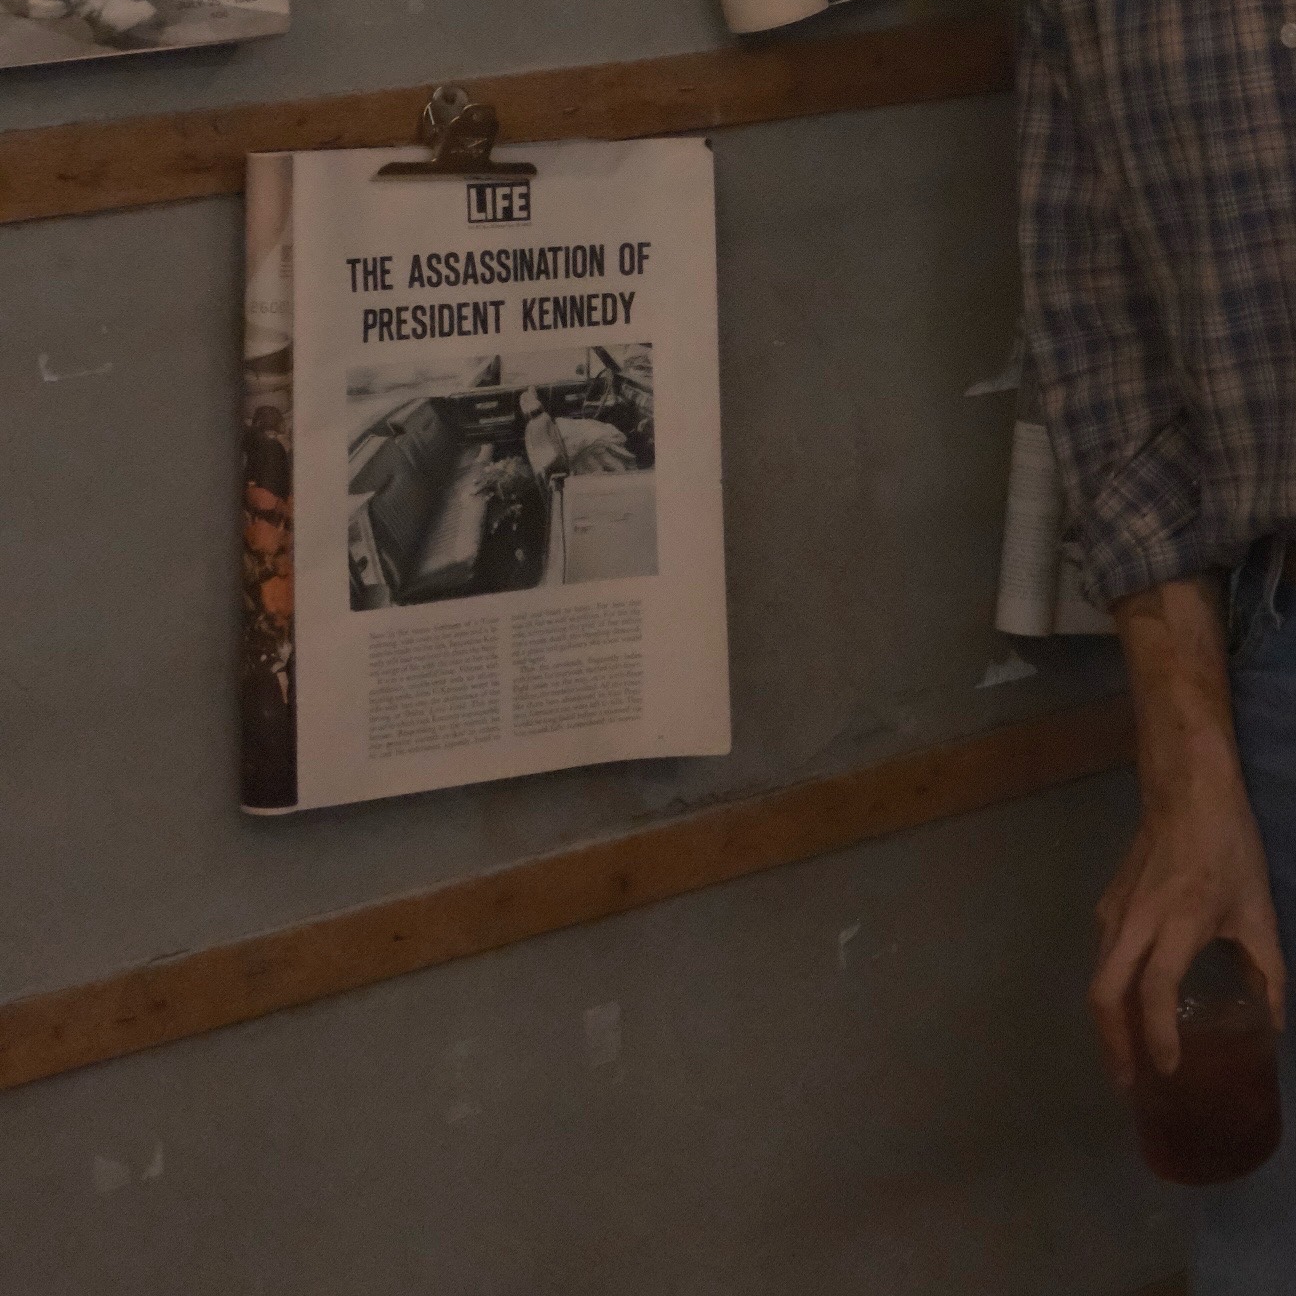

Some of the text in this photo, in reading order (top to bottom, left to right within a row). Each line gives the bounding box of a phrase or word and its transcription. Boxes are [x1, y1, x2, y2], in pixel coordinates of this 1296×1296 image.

[468, 184, 530, 222] LIFE
[346, 242, 652, 292] THE ASSASSINATION OF
[362, 291, 636, 343] PRESIDENT KENNEDY
